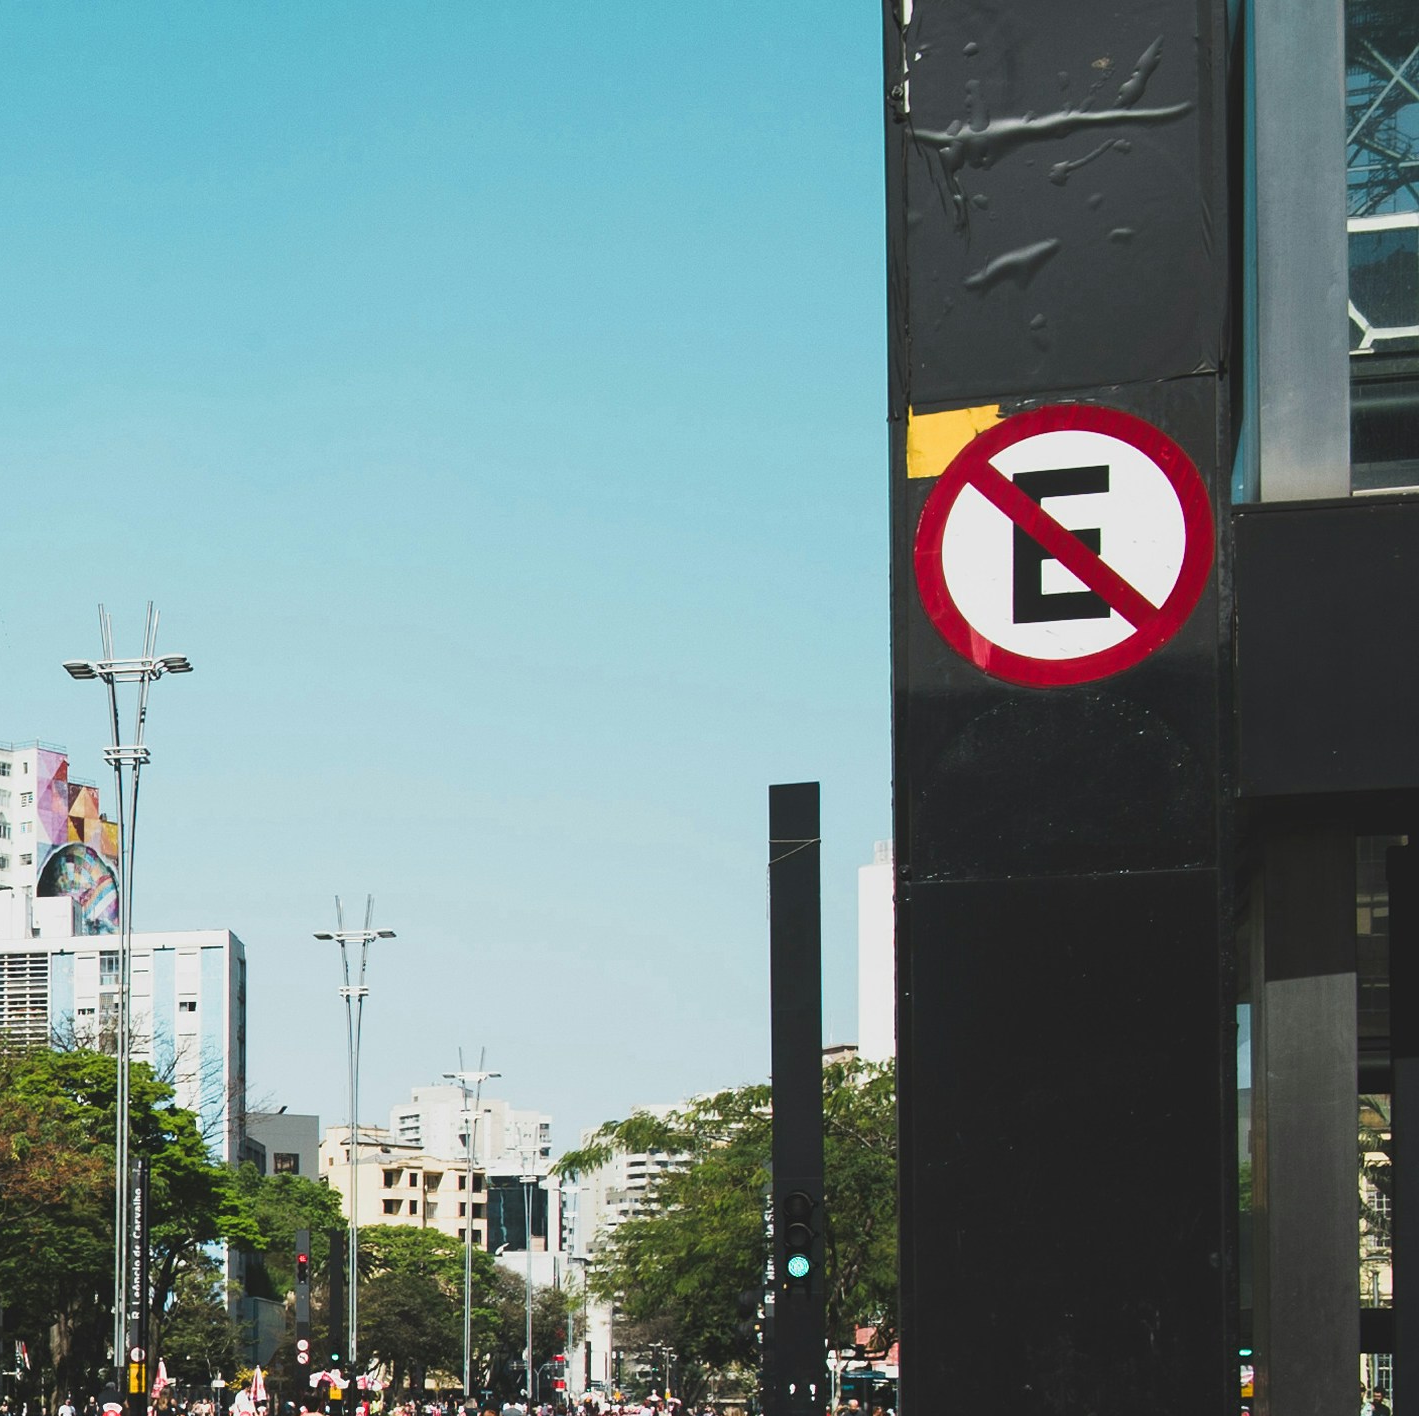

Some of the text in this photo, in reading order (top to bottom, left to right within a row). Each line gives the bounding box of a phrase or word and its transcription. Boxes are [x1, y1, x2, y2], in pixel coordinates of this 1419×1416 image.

[1013, 465, 1110, 624] E
[132, 1188, 142, 1239] Carvalho
[131, 1245, 141, 1258] de
